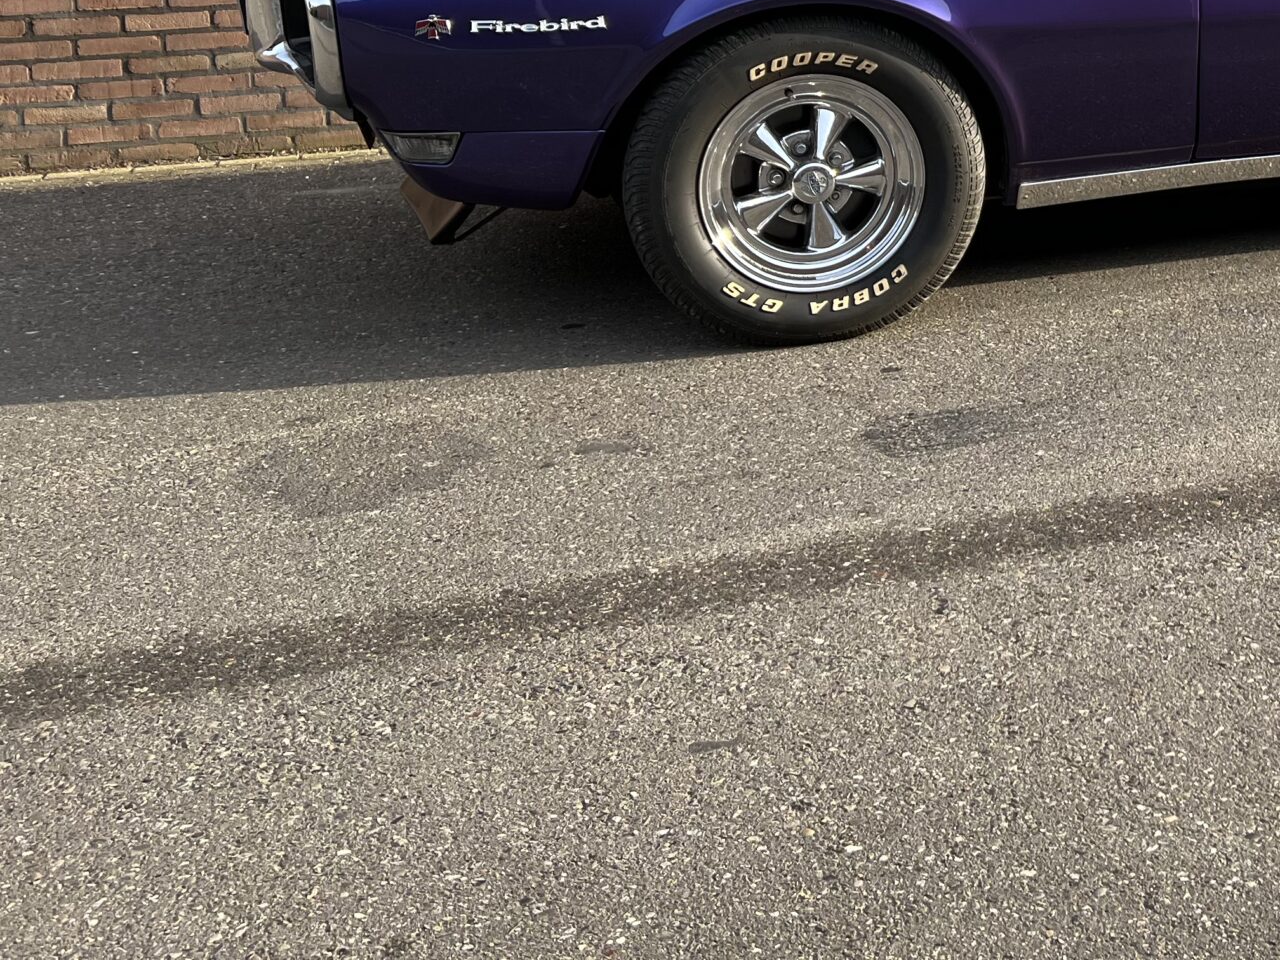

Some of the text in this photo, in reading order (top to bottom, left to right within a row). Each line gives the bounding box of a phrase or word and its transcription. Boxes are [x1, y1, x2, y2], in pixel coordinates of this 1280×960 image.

[470, 15, 608, 34] Firebird
[749, 51, 879, 82] COOPER
[722, 263, 909, 315] COBRA GTS
